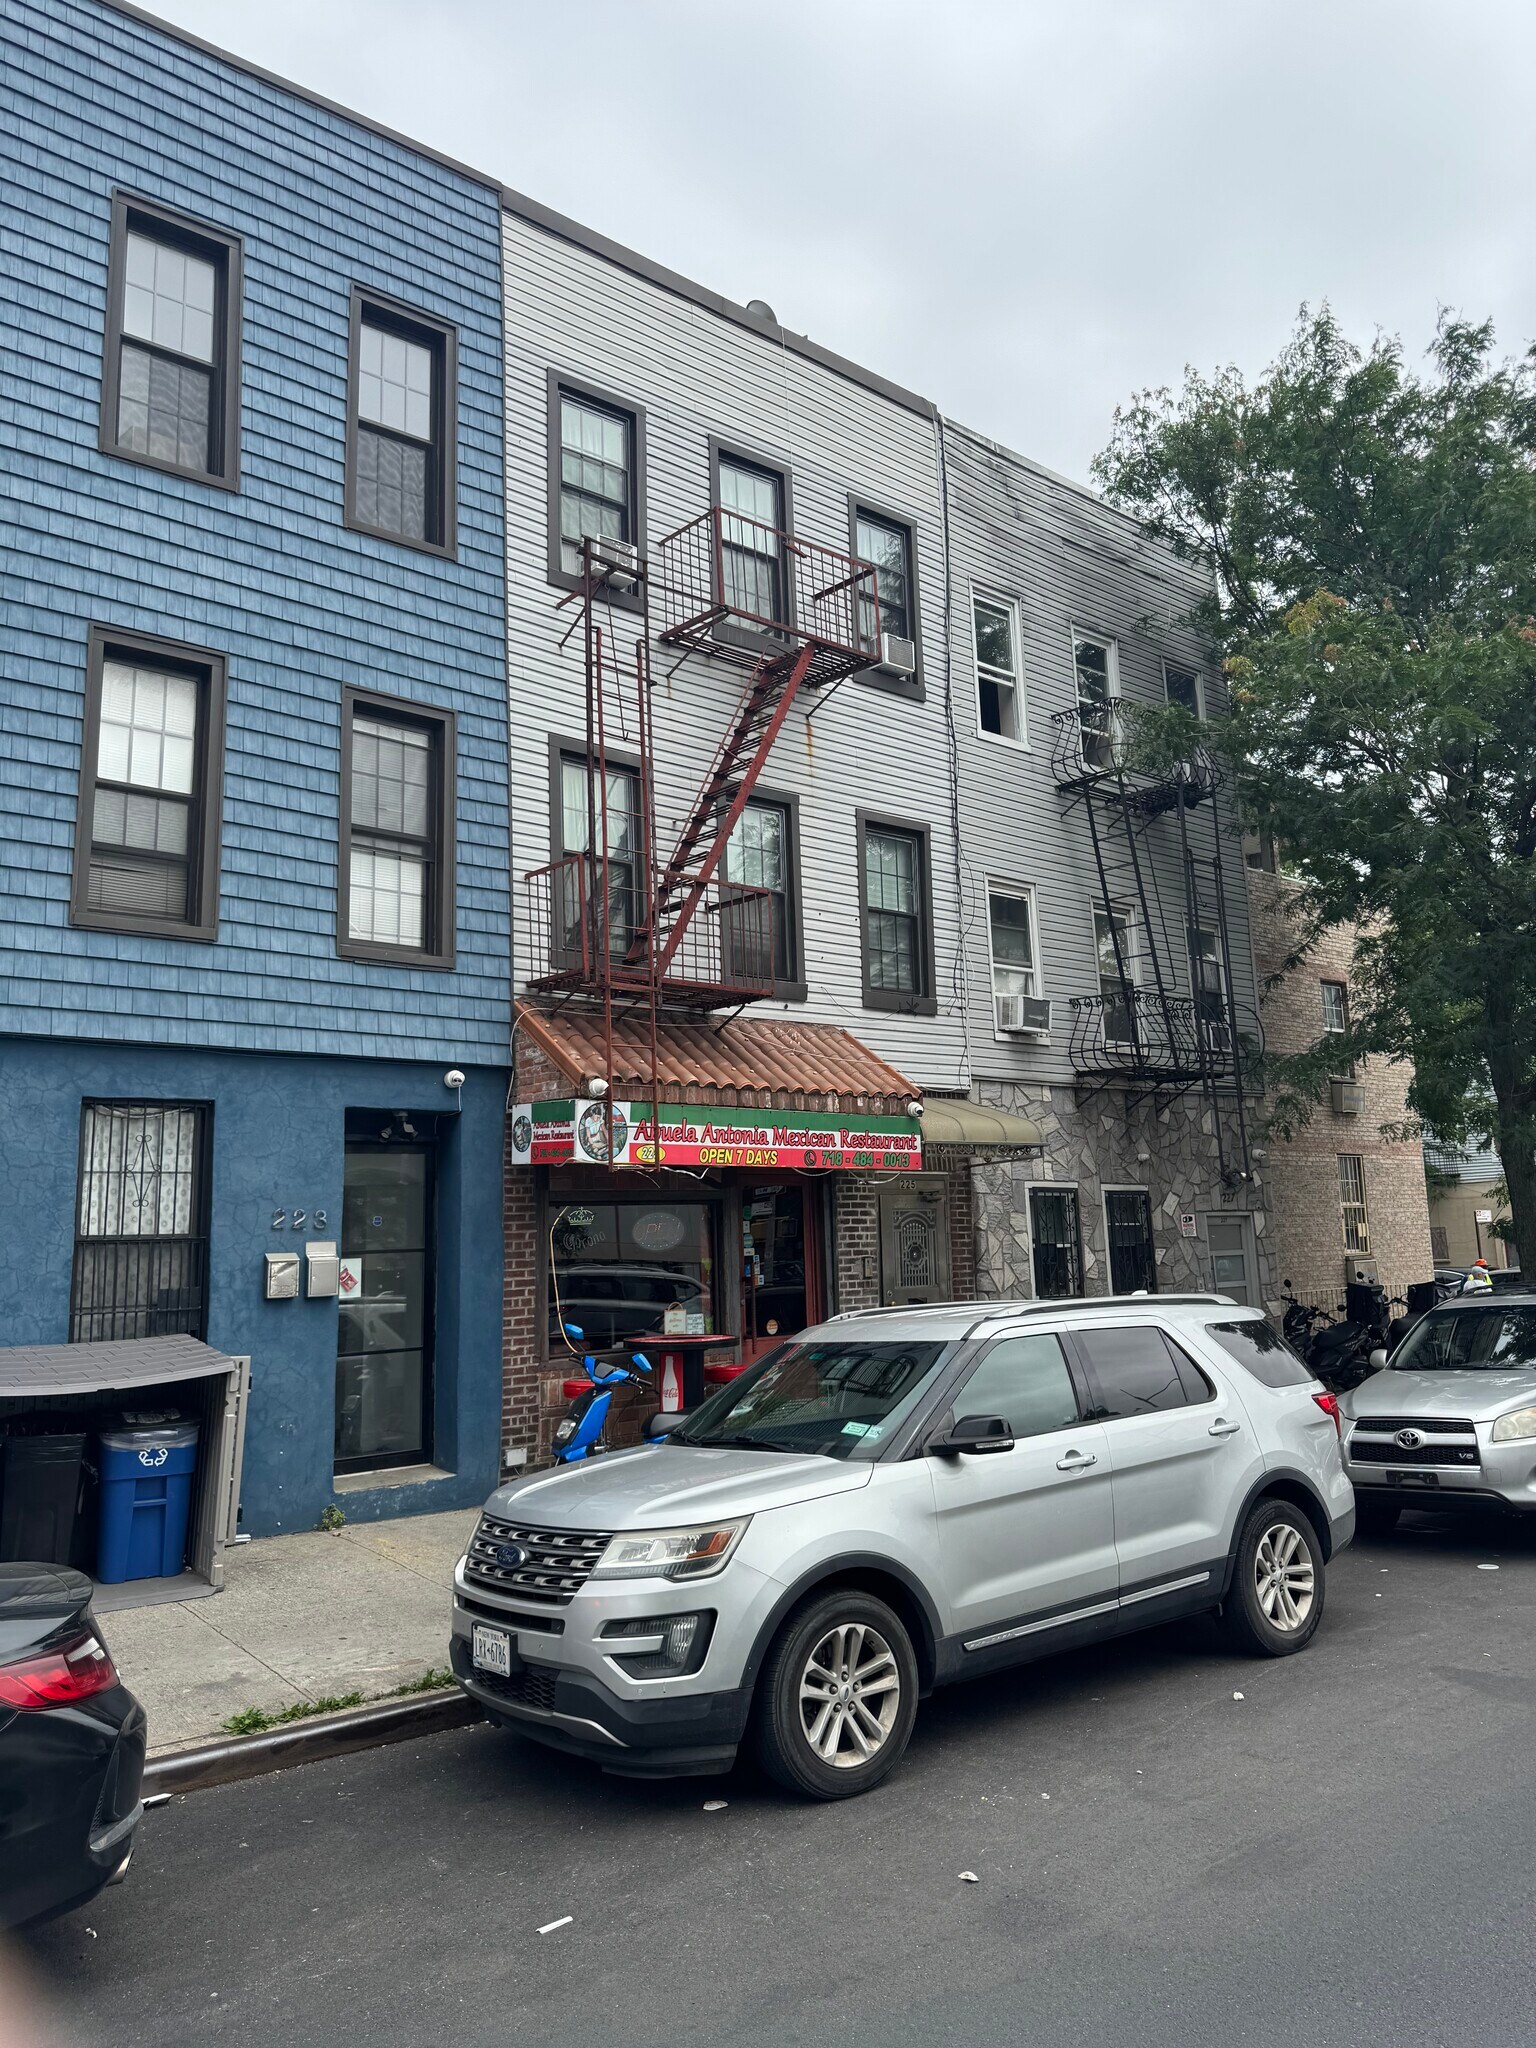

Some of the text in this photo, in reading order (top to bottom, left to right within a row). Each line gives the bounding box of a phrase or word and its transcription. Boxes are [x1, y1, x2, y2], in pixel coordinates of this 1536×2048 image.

[634, 1116, 917, 1151] Abuela Antonia Mexican Restaurant
[641, 1147, 658, 1160] 22
[699, 1148, 778, 1165] OPEN 7 DAYS
[900, 1181, 916, 1189] 225
[1222, 1193, 1236, 1203] 227
[272, 1207, 327, 1229] 223
